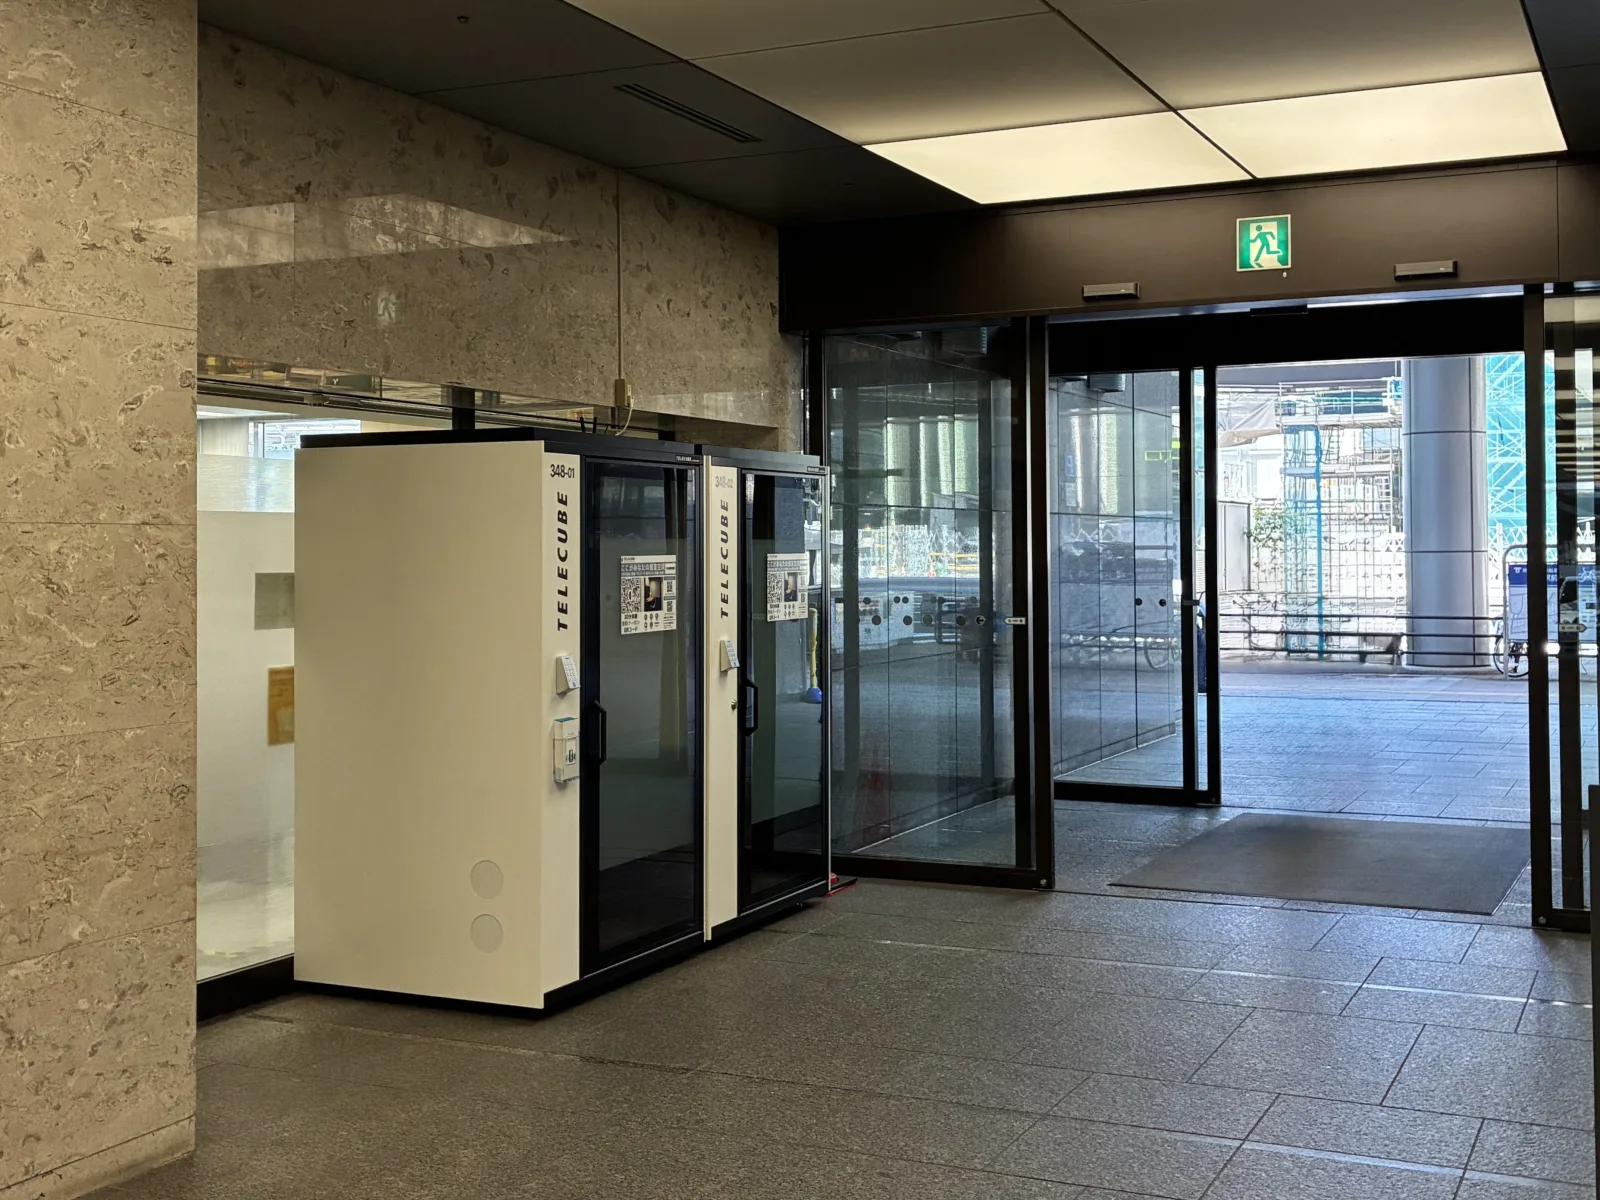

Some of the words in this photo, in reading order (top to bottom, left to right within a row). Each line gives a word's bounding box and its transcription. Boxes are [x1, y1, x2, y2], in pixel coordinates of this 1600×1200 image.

[550, 464, 575, 478] 348-01
[557, 491, 568, 631] TELECUBE
[720, 499, 729, 619] TELECUBE
